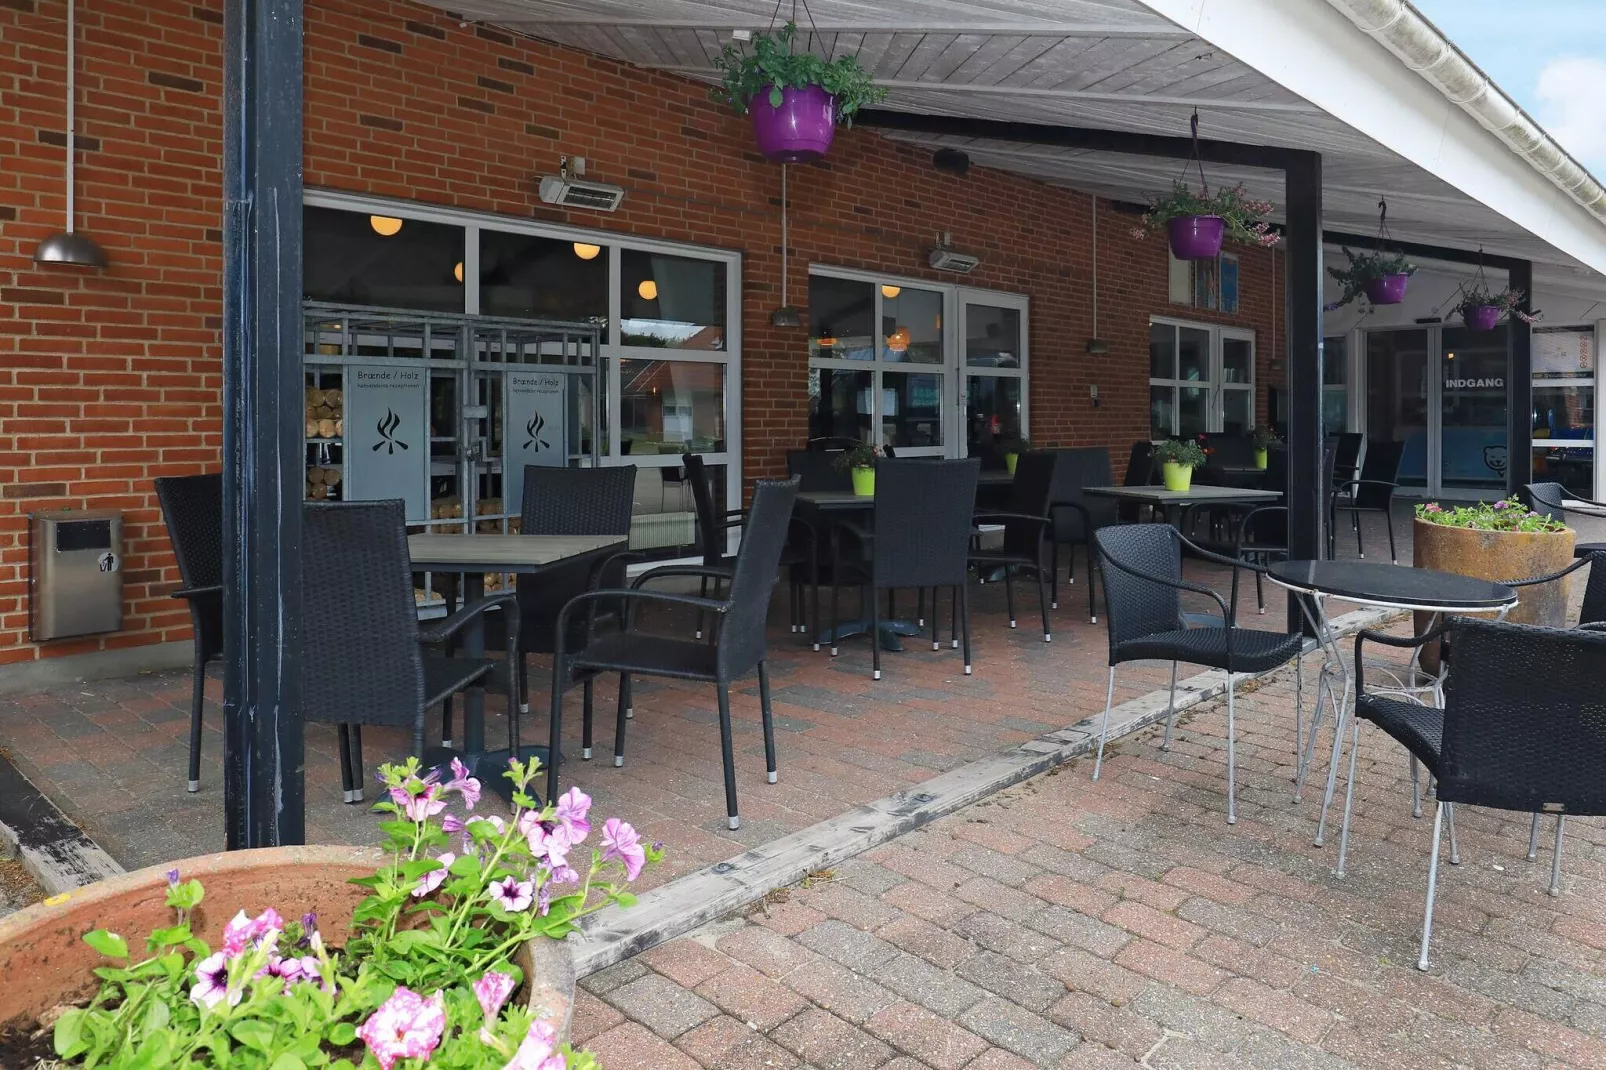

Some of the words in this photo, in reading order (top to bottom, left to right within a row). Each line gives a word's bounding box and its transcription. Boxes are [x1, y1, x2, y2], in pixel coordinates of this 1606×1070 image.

[357, 370, 391, 380] Brænde
[400, 371, 419, 380] Holz
[544, 378, 559, 386] Holz
[1445, 378, 1504, 388] INDGANG
